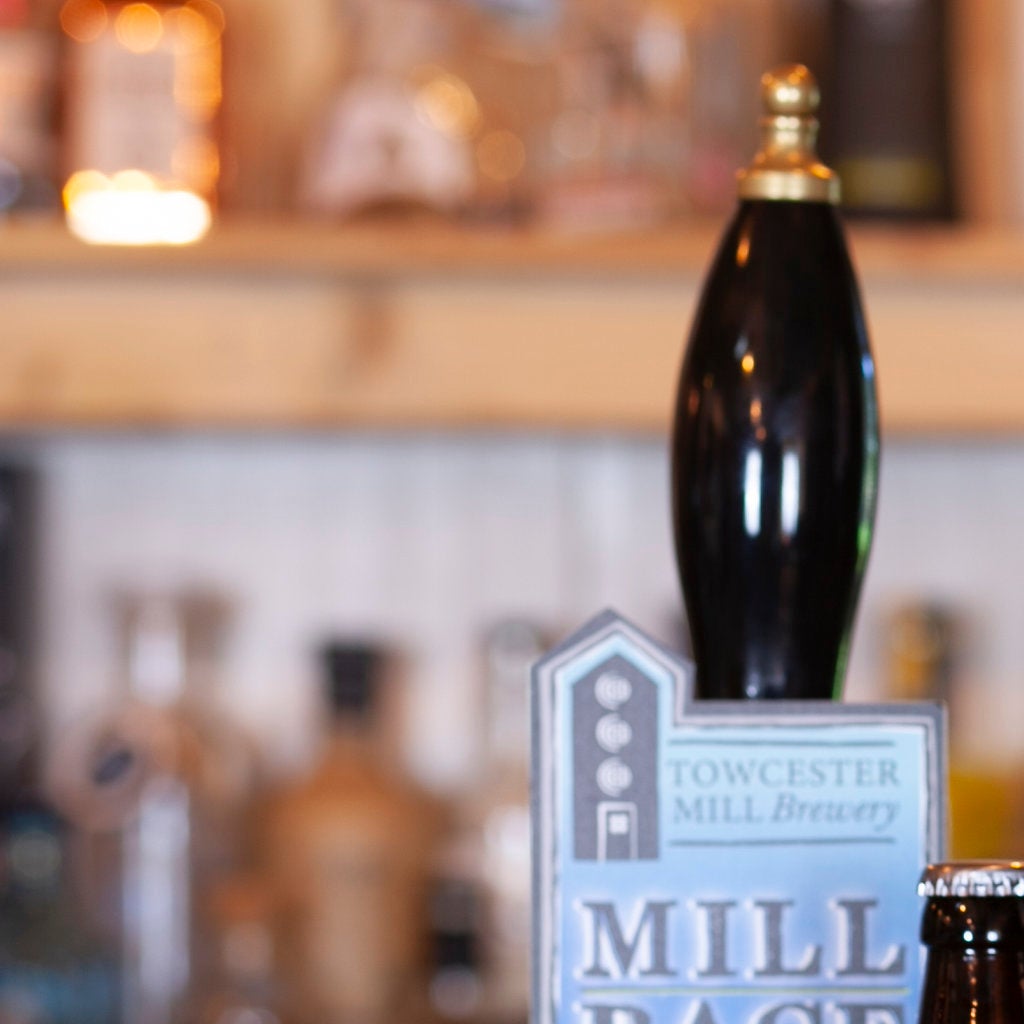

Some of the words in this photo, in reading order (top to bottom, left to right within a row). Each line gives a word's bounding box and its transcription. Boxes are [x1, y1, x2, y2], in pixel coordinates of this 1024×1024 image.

[668, 757, 901, 790] TOWCESTER
[672, 795, 766, 825] MILL
[771, 792, 901, 831] Brewery
[573, 897, 909, 979] MILL
